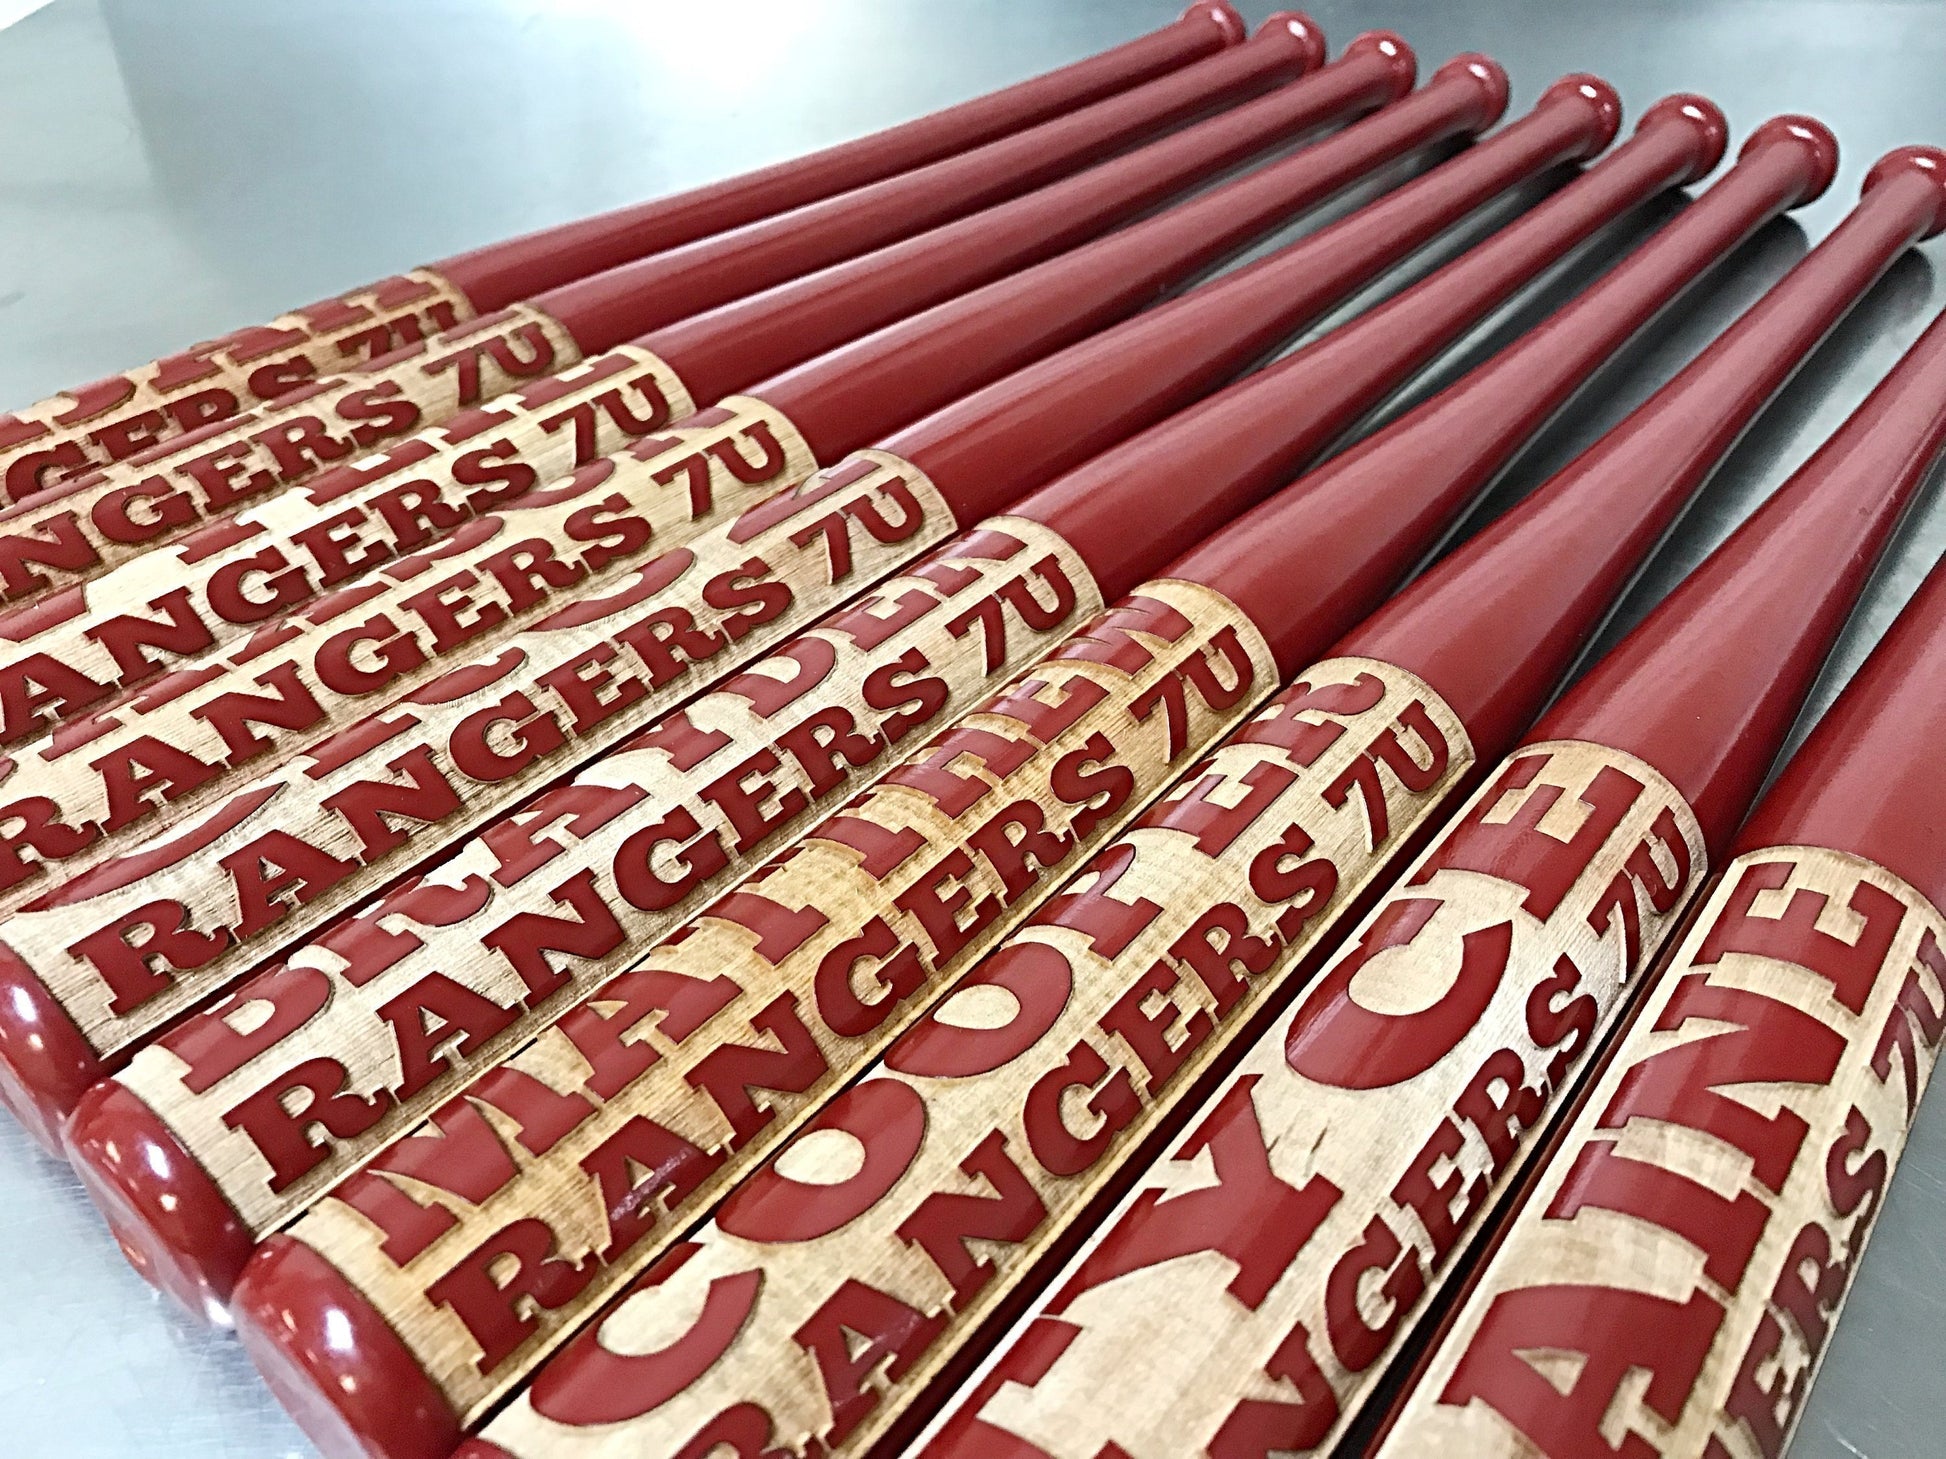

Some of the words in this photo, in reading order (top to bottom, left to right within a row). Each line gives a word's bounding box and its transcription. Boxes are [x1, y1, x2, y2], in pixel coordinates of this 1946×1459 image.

[419, 321, 557, 405] 7U
[537, 372, 670, 467] 7U
[0, 491, 652, 892] RANGERS
[649, 419, 786, 521] 7U
[67, 556, 794, 1017] RANGERS
[788, 474, 925, 584] 7U
[221, 647, 951, 1194] RANGERS
[945, 554, 1077, 678] 7U
[1322, 706, 1450, 854] 7U
[1586, 809, 1694, 985] 7U
[332, 590, 1195, 1268] MATTHEW
[426, 730, 1135, 1374] RANGERS
[1128, 623, 1254, 763] 7U
[527, 667, 1385, 1426] COOPER
